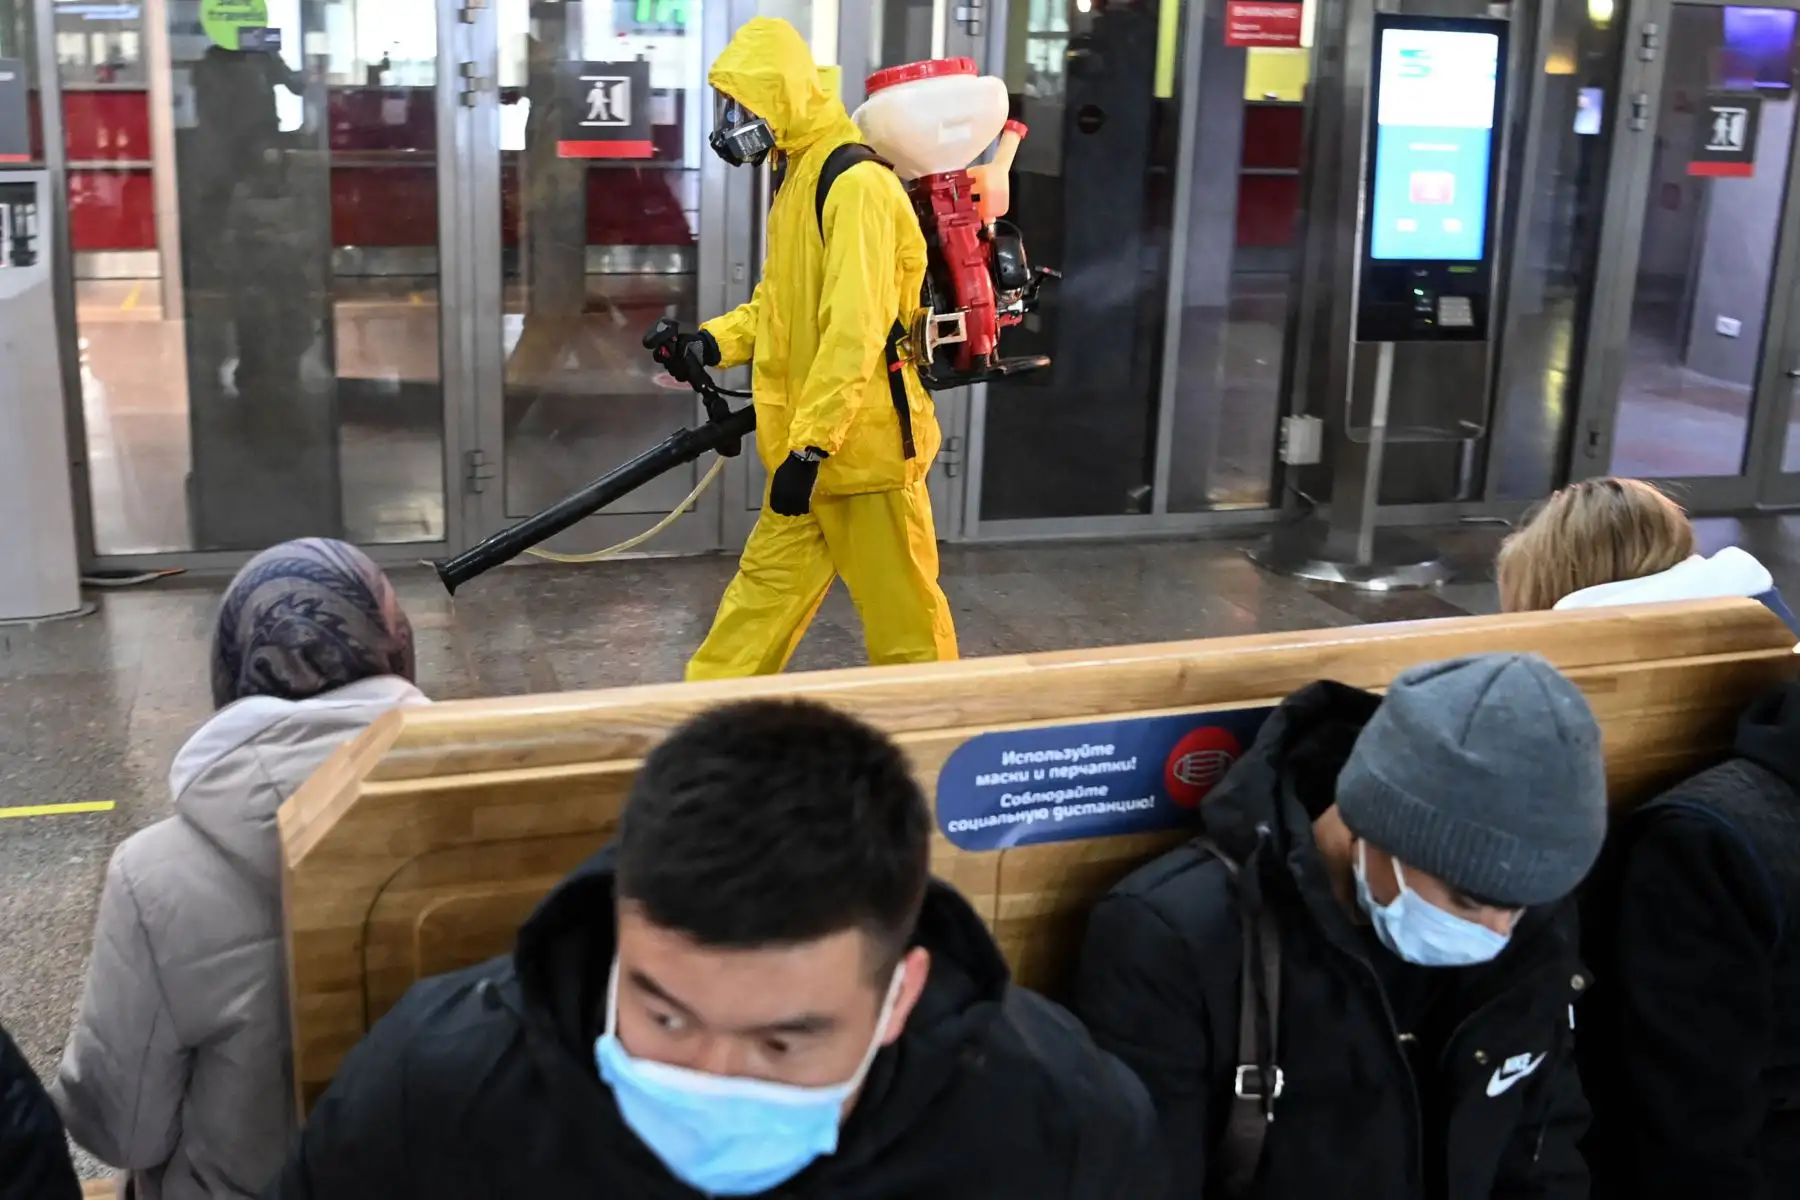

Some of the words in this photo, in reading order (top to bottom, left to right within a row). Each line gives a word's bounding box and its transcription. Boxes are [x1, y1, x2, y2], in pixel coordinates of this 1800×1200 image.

[1002, 743, 1115, 766] Используйте
[975, 768, 1029, 786] маски
[1033, 767, 1045, 780] и
[1049, 756, 1137, 779] перчатки!
[1000, 785, 1108, 807] Соблюдайте
[948, 808, 1049, 832] социальную
[1052, 796, 1155, 820] дистанцию!
